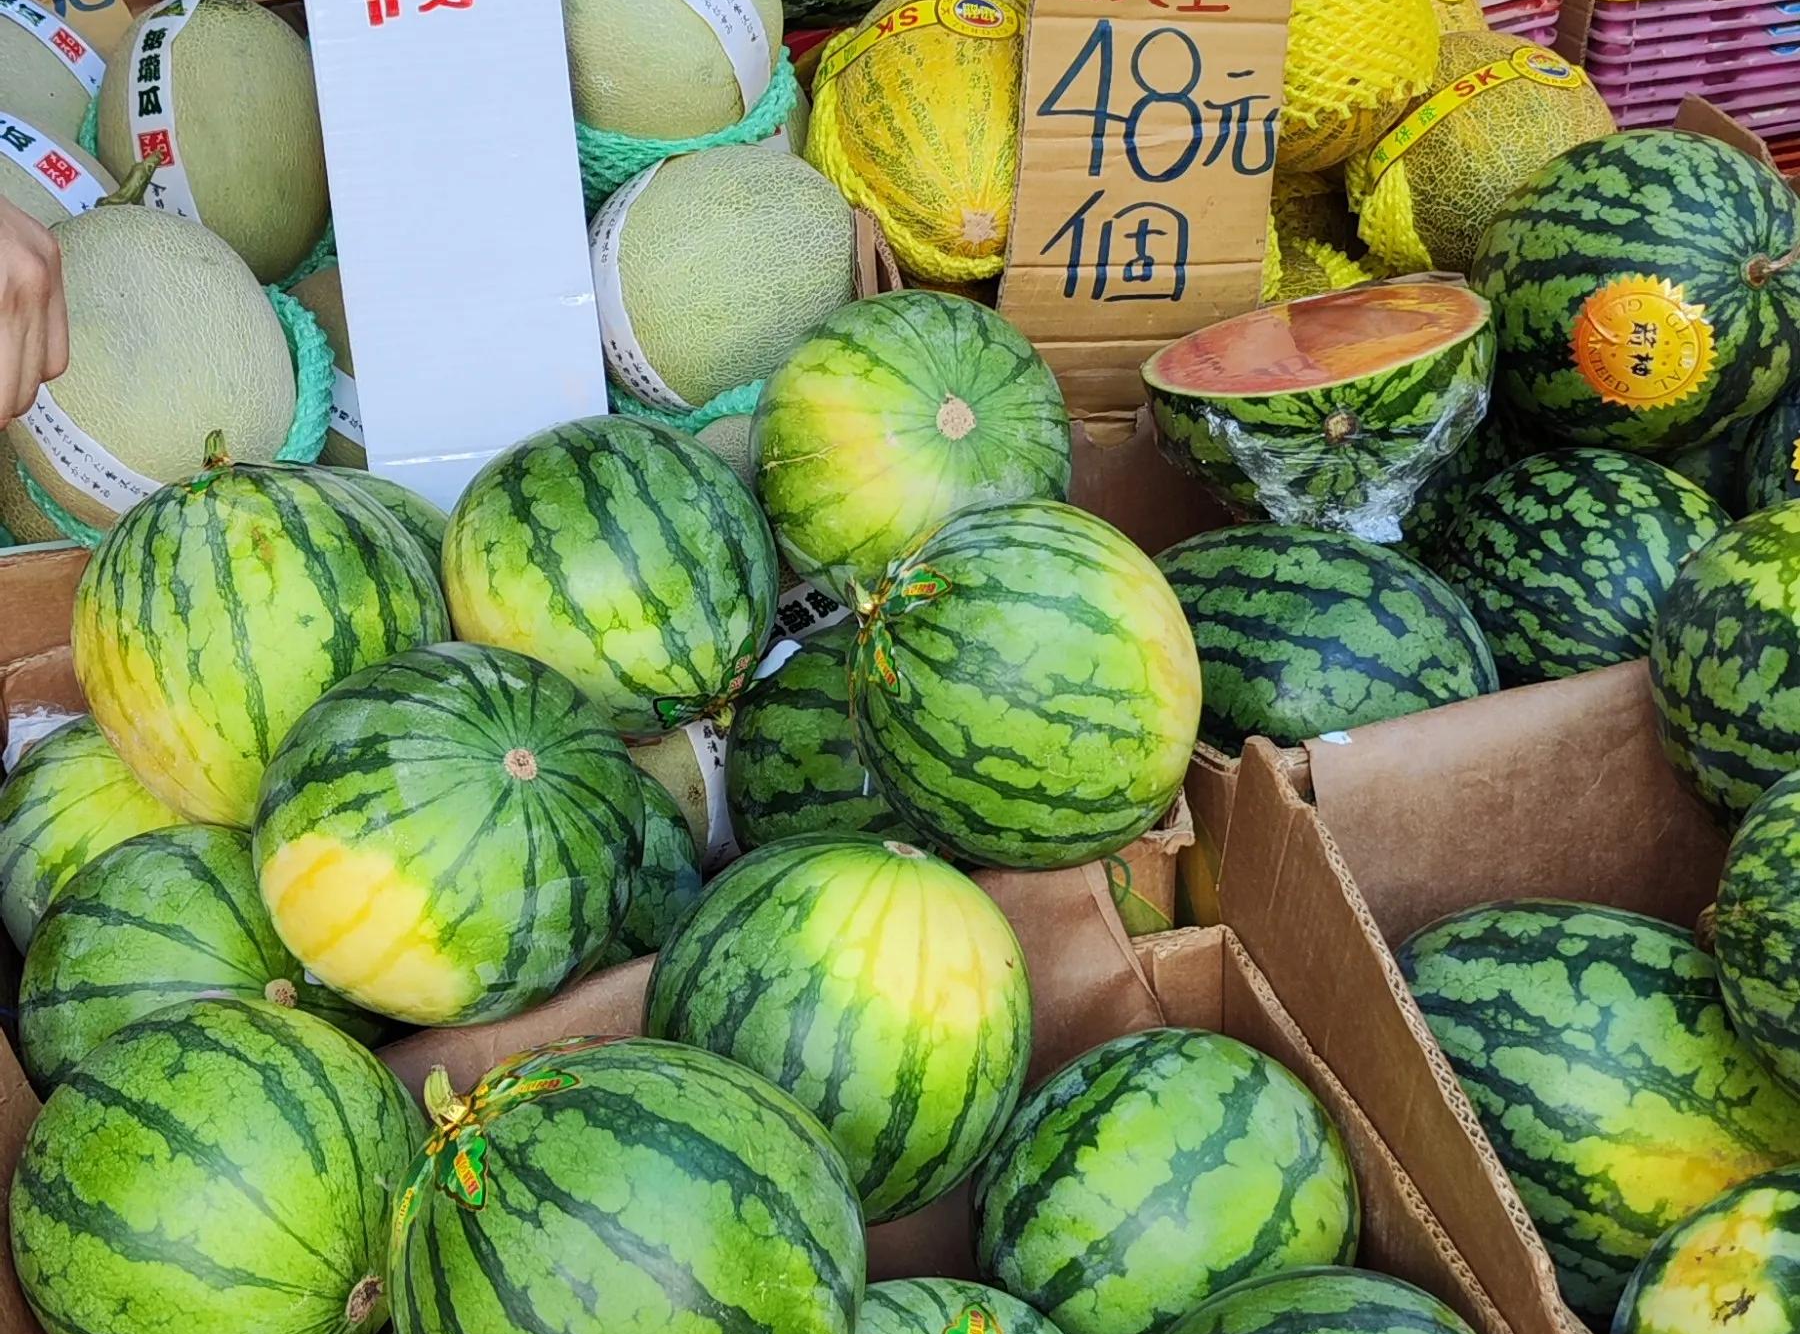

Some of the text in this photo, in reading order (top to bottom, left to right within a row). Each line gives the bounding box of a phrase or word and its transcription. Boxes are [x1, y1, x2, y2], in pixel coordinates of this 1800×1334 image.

[1037, 18, 1280, 183] 48元
[1453, 66, 1502, 99] SK
[1040, 189, 1190, 303] 個
